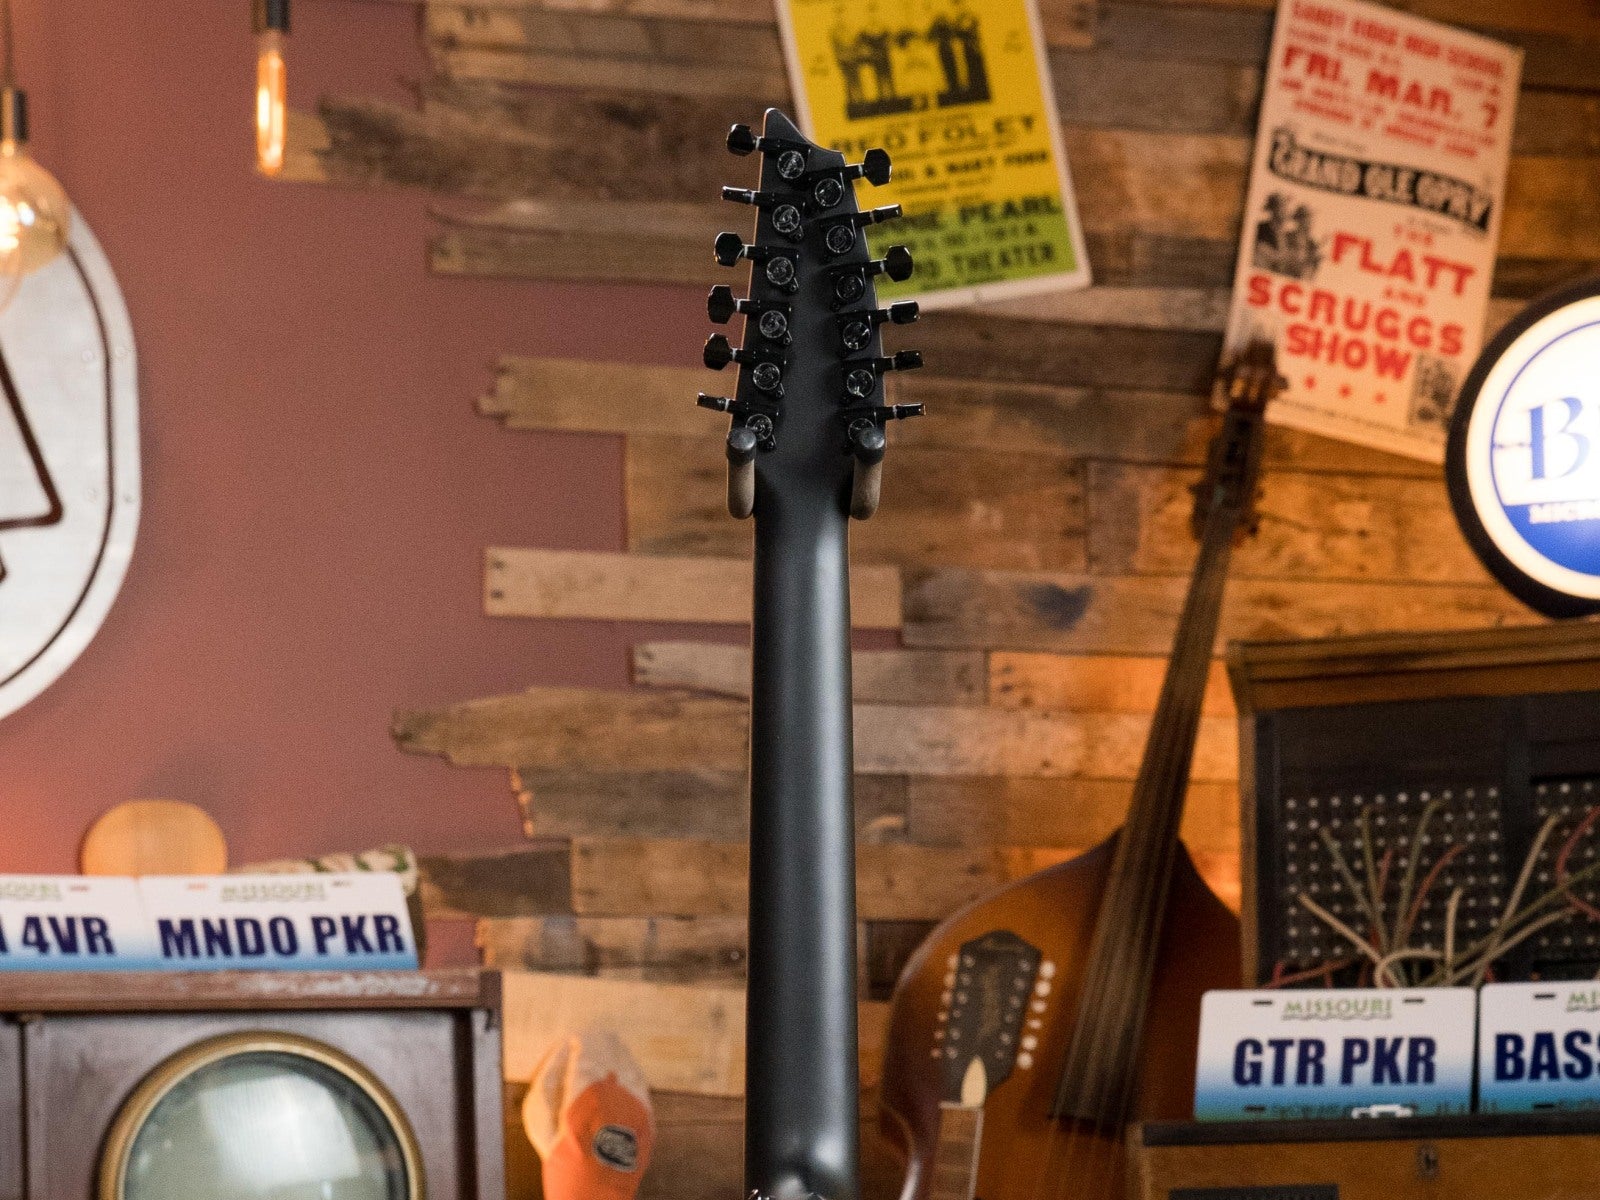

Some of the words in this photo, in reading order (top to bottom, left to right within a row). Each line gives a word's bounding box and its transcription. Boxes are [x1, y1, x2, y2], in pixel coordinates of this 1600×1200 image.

[918, 114, 1035, 146] FOLEY
[1482, 101, 1499, 129] 7
[1364, 164, 1411, 204] OLE
[1416, 172, 1491, 230] OPRY
[1331, 229, 1477, 297] FLATT
[1247, 273, 1464, 357] SCRUGGS
[1286, 323, 1412, 383] SHOW
[1528, 396, 1600, 480] B
[22, 915, 114, 955] 4VR
[157, 916, 300, 959] MNDO
[312, 914, 406, 956] PKR
[1283, 997, 1392, 1016] MISSOURI
[1233, 1036, 1326, 1087] GTR
[1341, 1035, 1437, 1086] PKR
[1495, 1029, 1600, 1082] BAS
